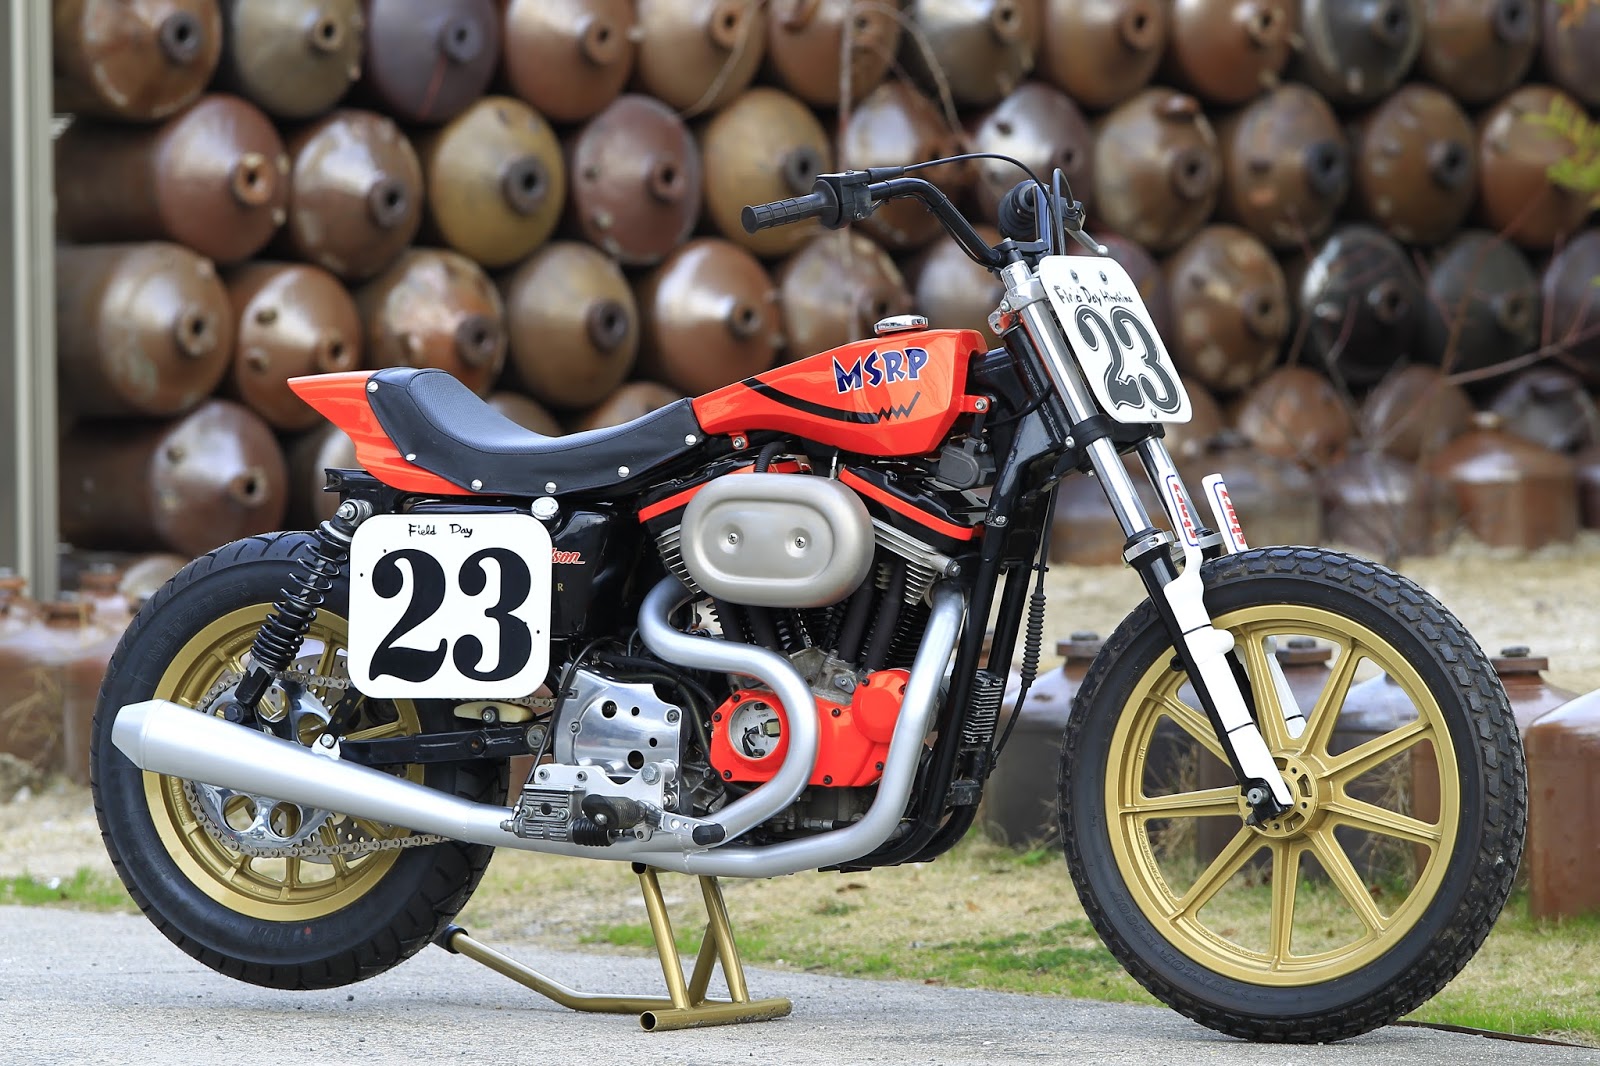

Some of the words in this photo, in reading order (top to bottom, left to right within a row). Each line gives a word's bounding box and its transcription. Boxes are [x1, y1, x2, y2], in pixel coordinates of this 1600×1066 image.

[832, 347, 929, 394] MSRP
[1074, 304, 1181, 414] 23
[408, 523, 437, 537] Field
[449, 523, 474, 538] Day
[557, 582, 565, 592] R
[368, 547, 532, 683] 23
